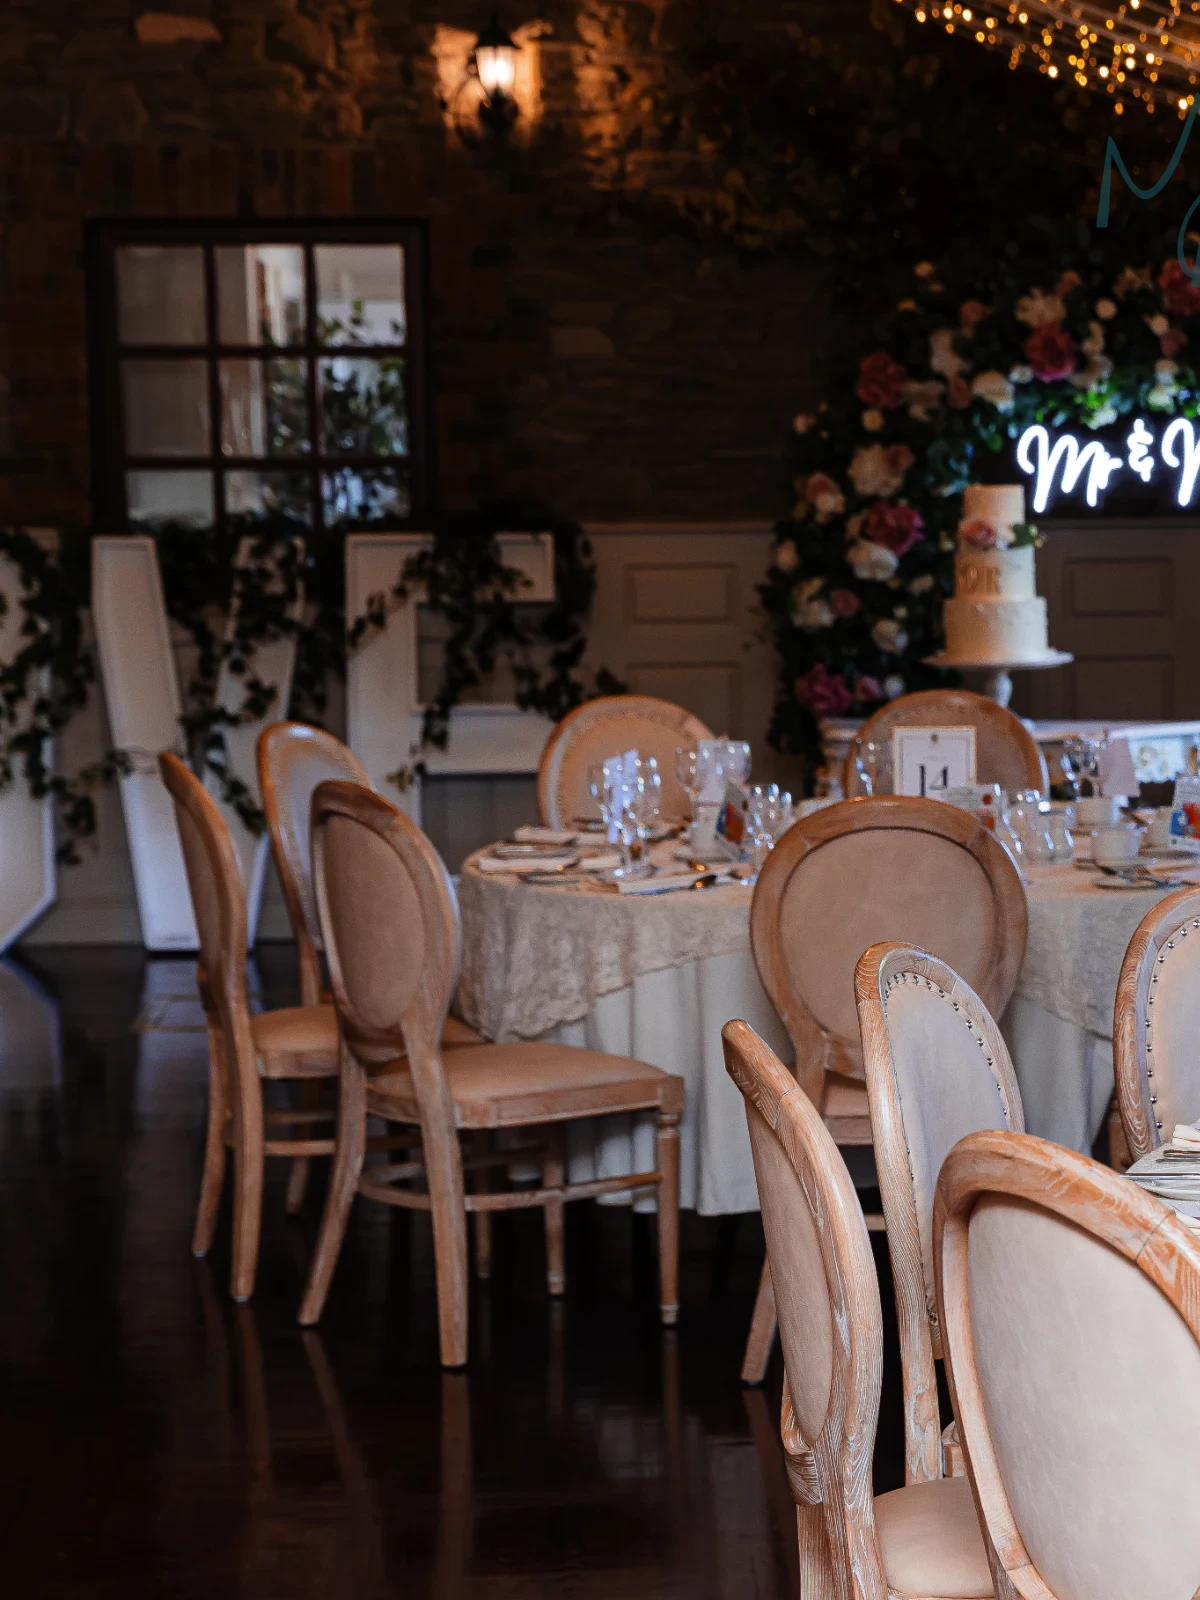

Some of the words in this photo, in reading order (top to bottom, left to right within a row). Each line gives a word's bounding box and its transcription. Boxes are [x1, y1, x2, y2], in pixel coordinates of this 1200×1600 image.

[1017, 424, 1123, 513] Mr
[1127, 418, 1154, 482] &
[919, 763, 949, 797] 14
